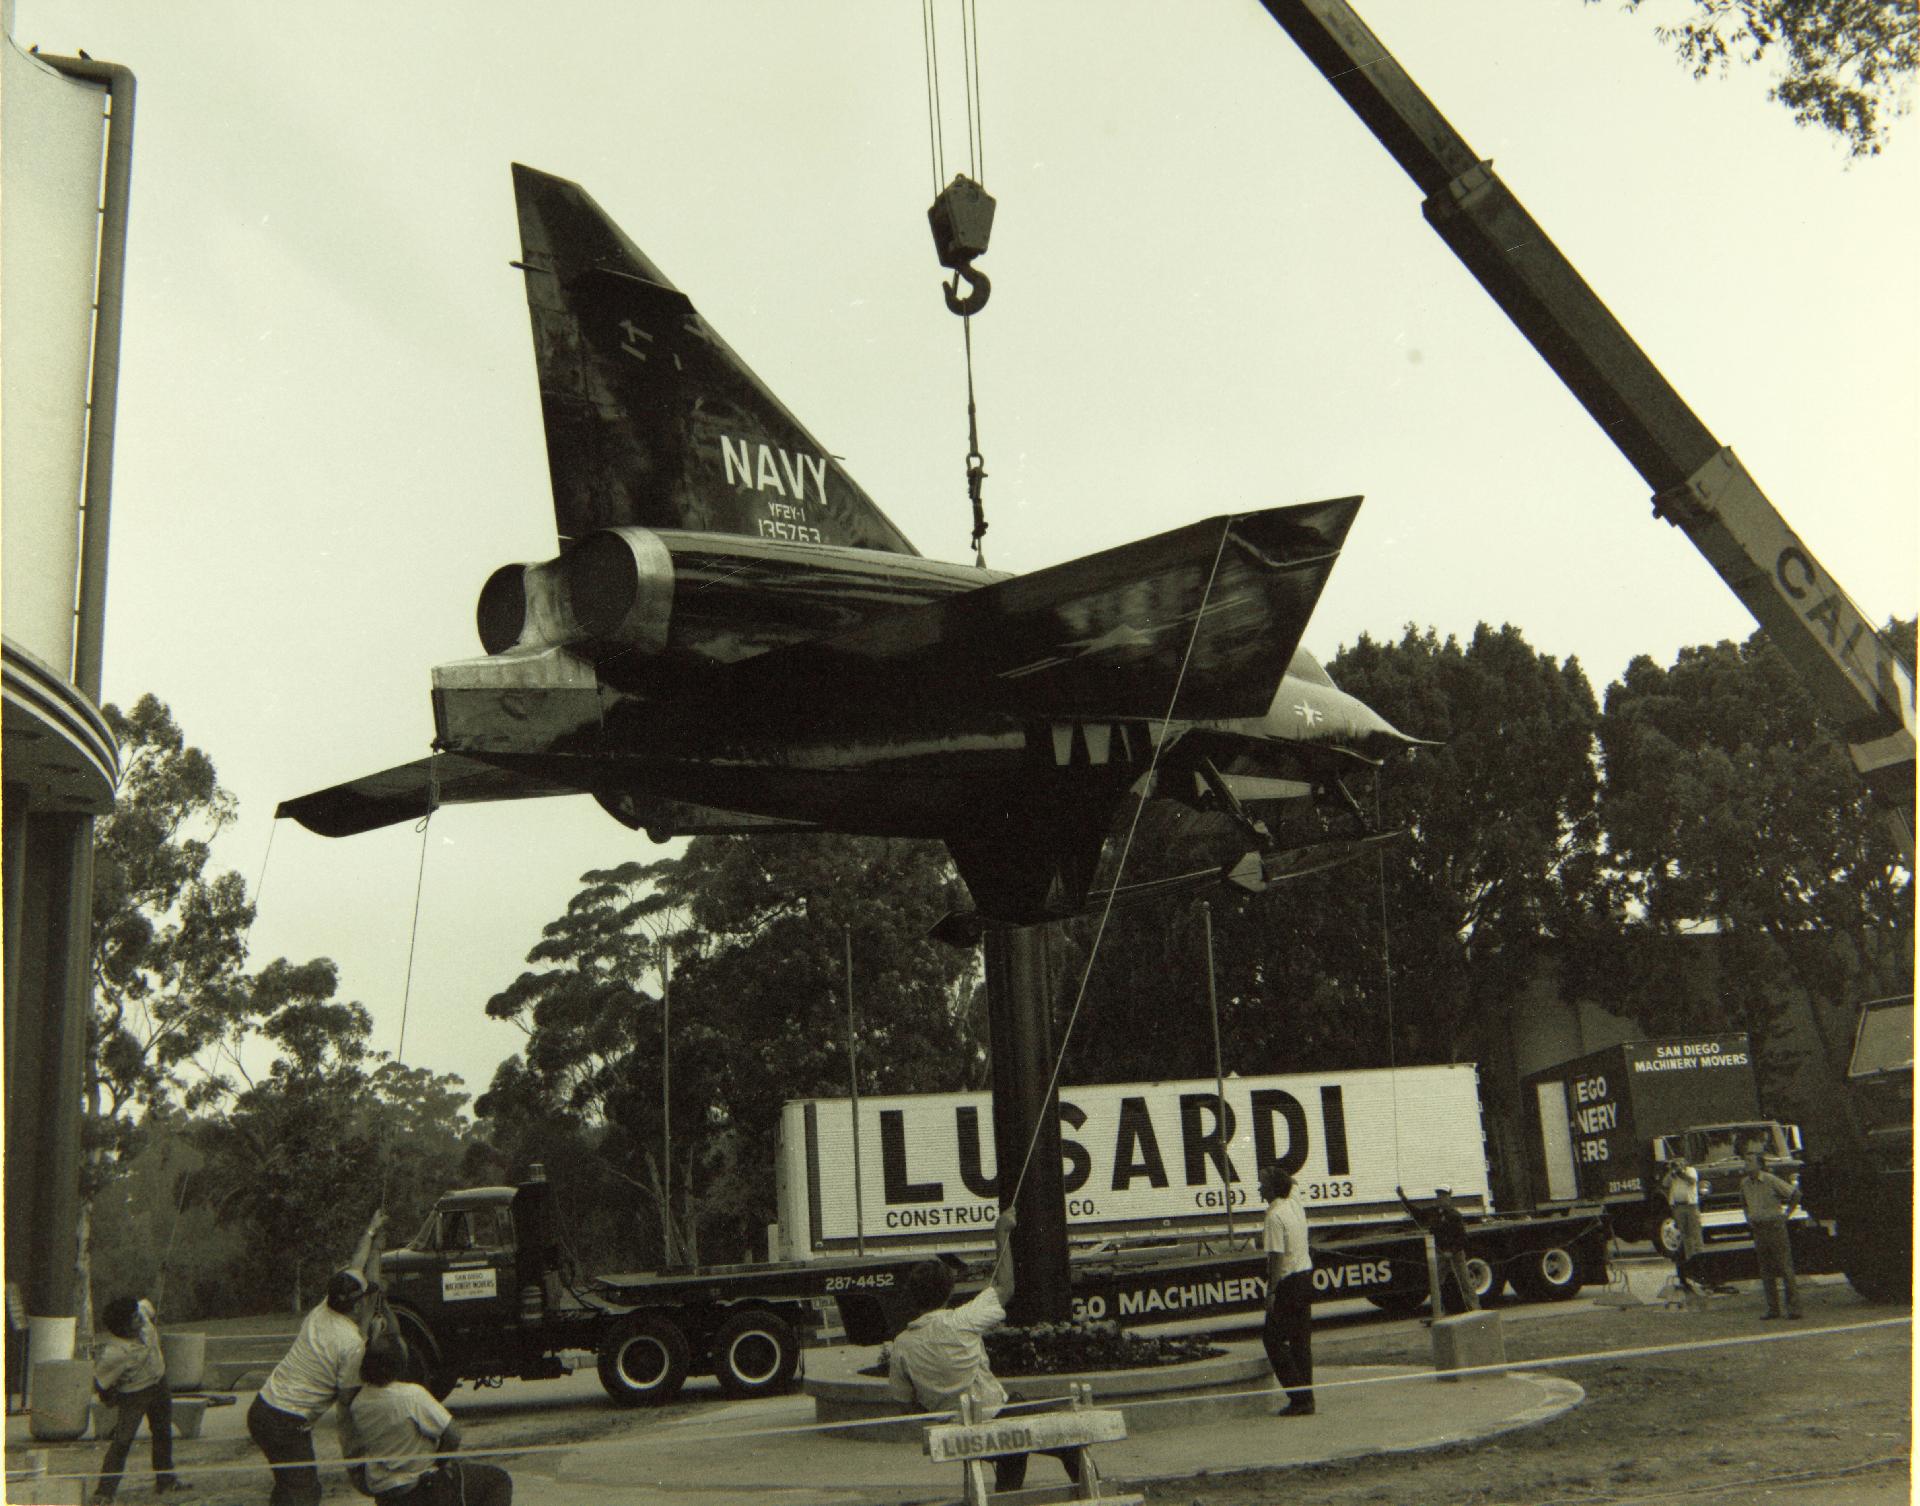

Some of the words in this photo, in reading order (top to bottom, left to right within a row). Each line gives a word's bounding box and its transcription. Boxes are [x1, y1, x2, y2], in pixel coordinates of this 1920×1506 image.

[720, 435, 827, 505] NAVY
[768, 502, 805, 521] YF2Y-1
[759, 519, 821, 543] 135763
[1634, 1057, 1697, 1072] MACHINERY
[1701, 1053, 1748, 1067] MOVERS
[1656, 1047, 1681, 1058] SAN
[1684, 1043, 1720, 1056] DIEGO
[880, 1085, 1350, 1205] LUSARDI
[1575, 1139, 1608, 1162] ERS
[886, 1203, 999, 1228] CONSTRUC
[1069, 1200, 1100, 1216] CO.
[1118, 1275, 1270, 1315] MACHINERY
[1312, 1260, 1392, 1291] OVERS
[942, 1428, 1033, 1457] LUSARDI
